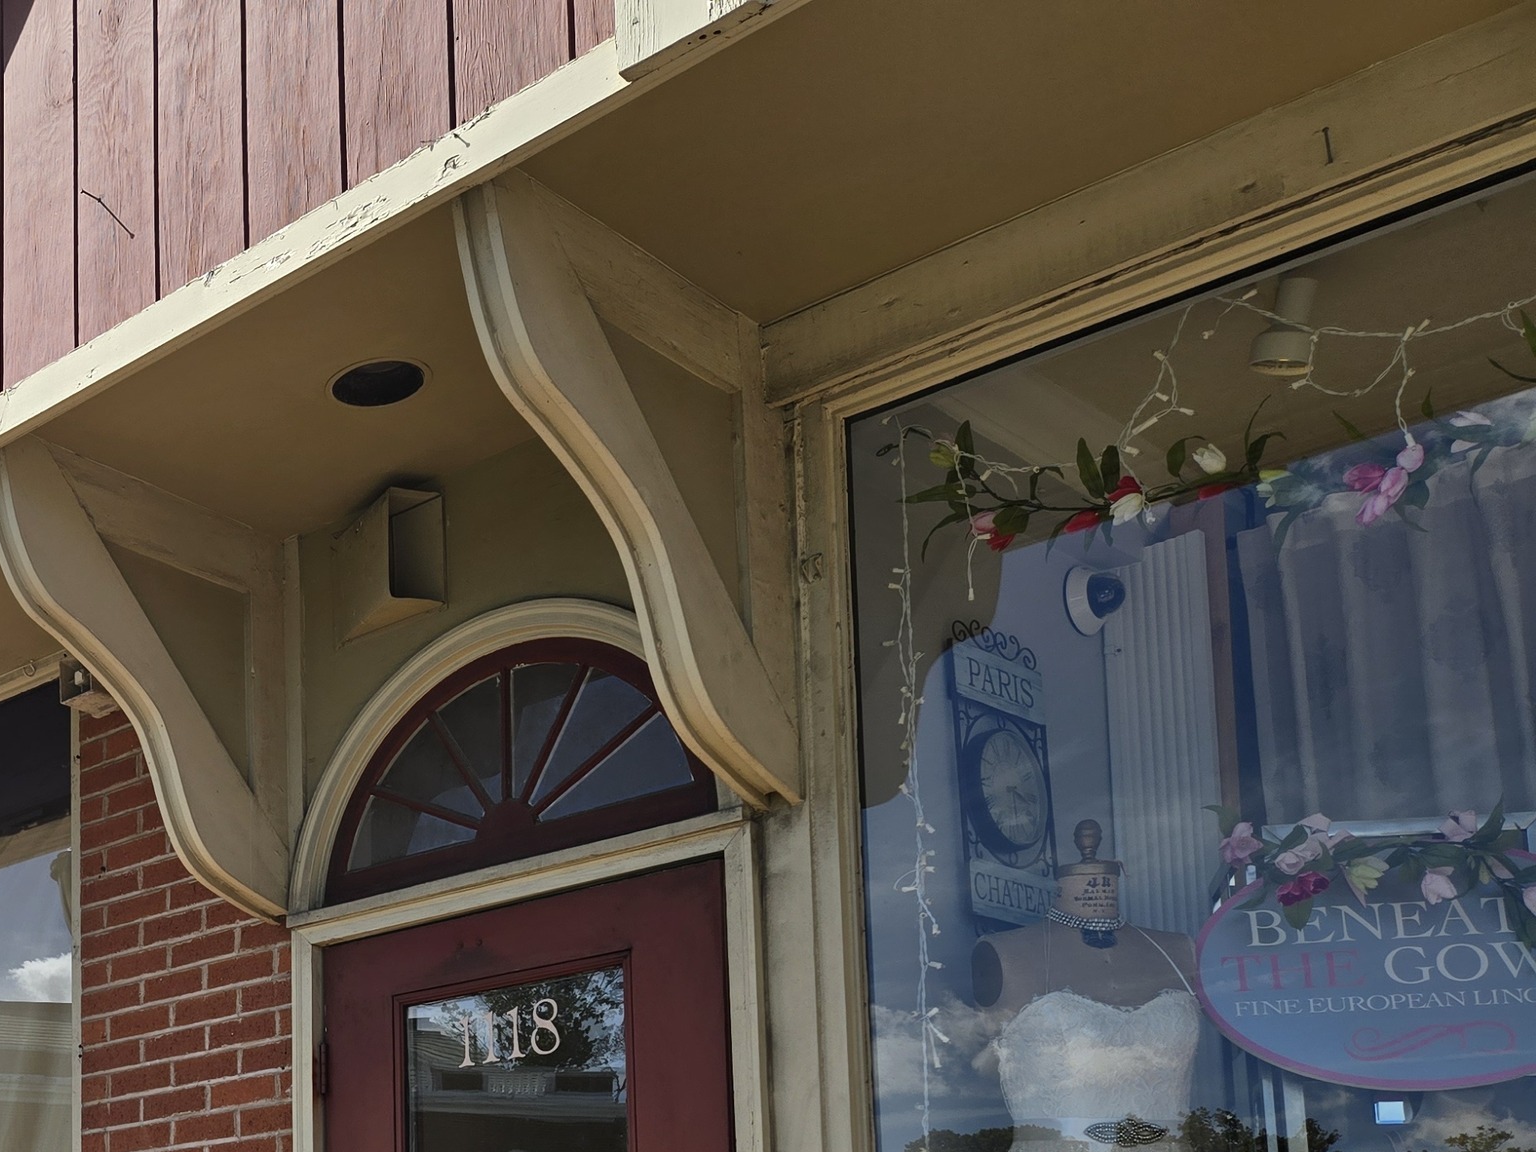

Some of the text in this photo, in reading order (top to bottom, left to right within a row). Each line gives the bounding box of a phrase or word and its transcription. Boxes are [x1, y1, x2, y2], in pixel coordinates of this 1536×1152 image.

[966, 656, 1034, 709] PARIS
[1242, 896, 1515, 947] BENEAT
[1221, 950, 1364, 993] THE
[1235, 999, 1303, 1017] FINE
[1309, 990, 1465, 1013] EUROPEAN
[458, 998, 560, 1068] 1118
